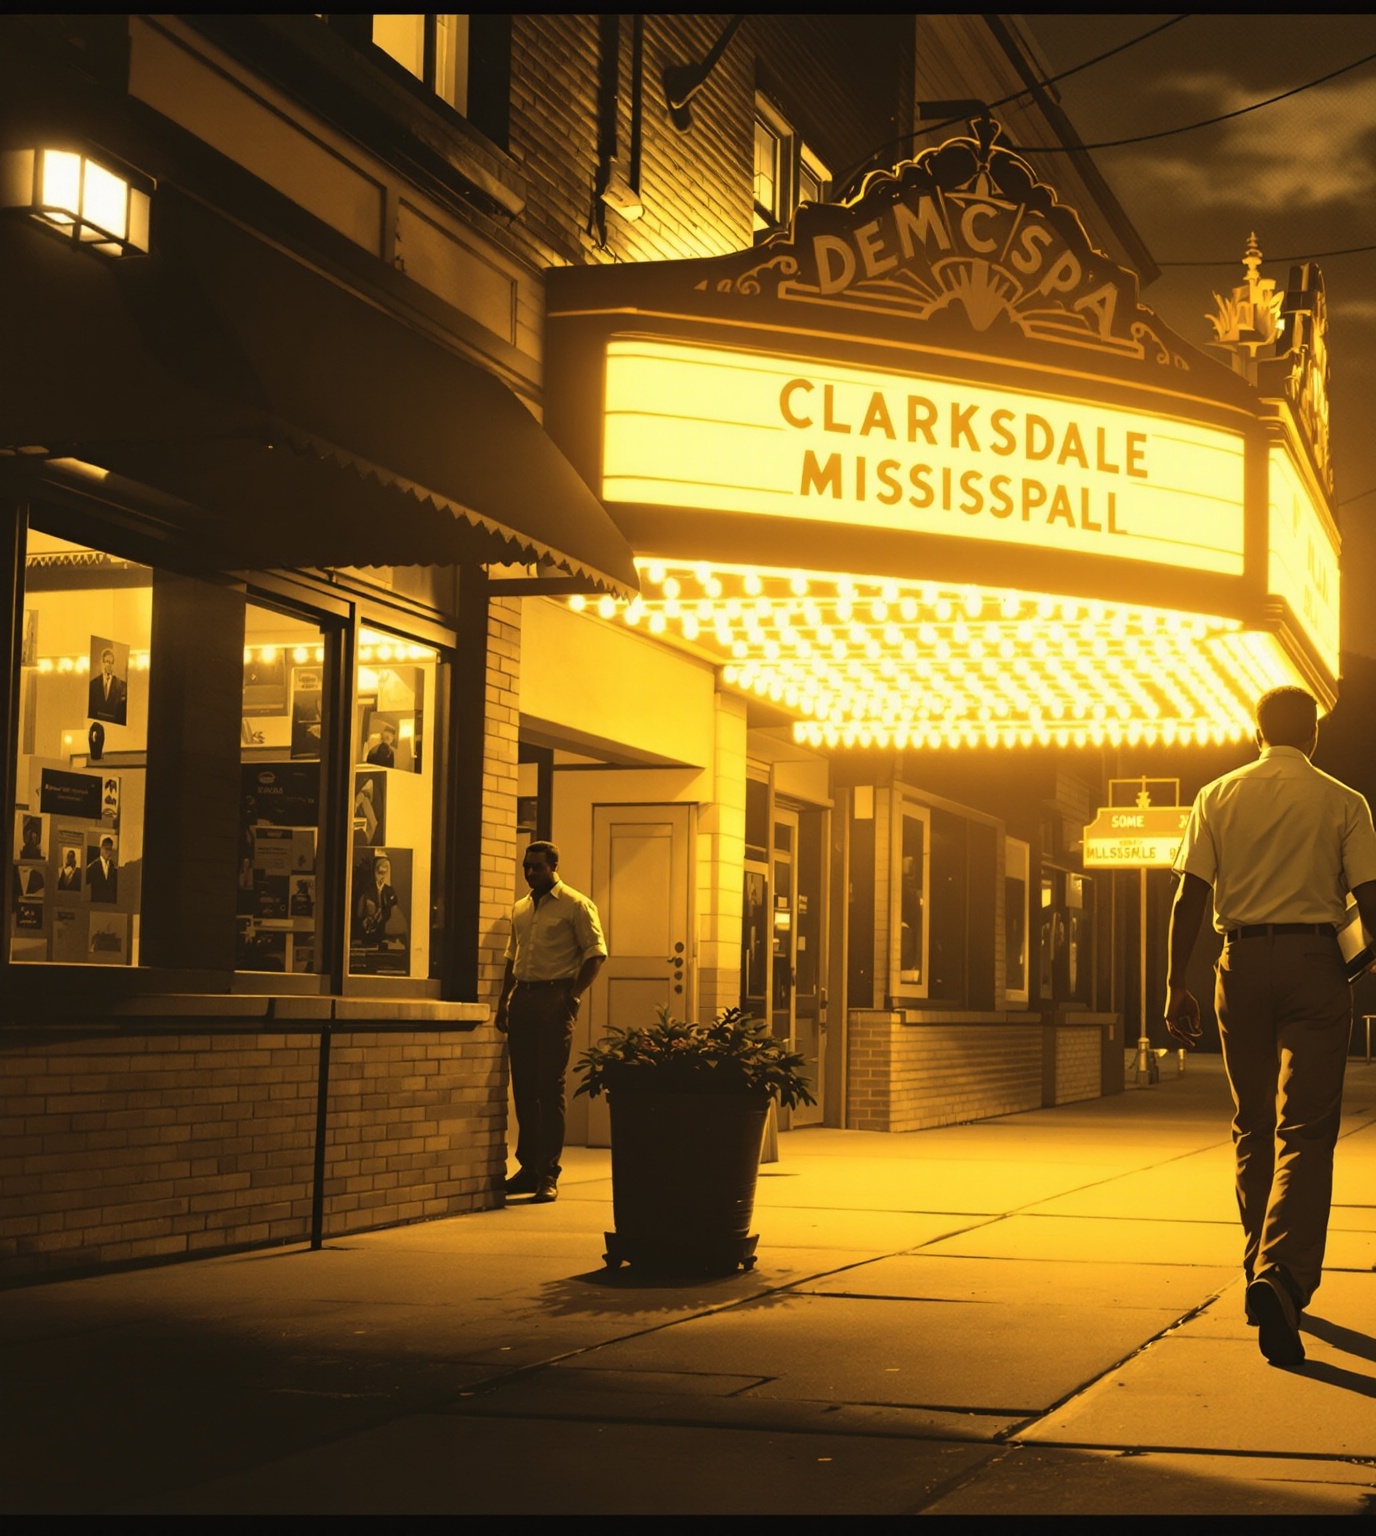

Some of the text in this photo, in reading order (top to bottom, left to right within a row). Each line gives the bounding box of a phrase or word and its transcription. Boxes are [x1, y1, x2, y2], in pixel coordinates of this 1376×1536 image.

[779, 378, 1149, 479] CLARKSDALE
[800, 449, 1128, 535] MISSISSPALL
[1111, 815, 1145, 828] SOME
